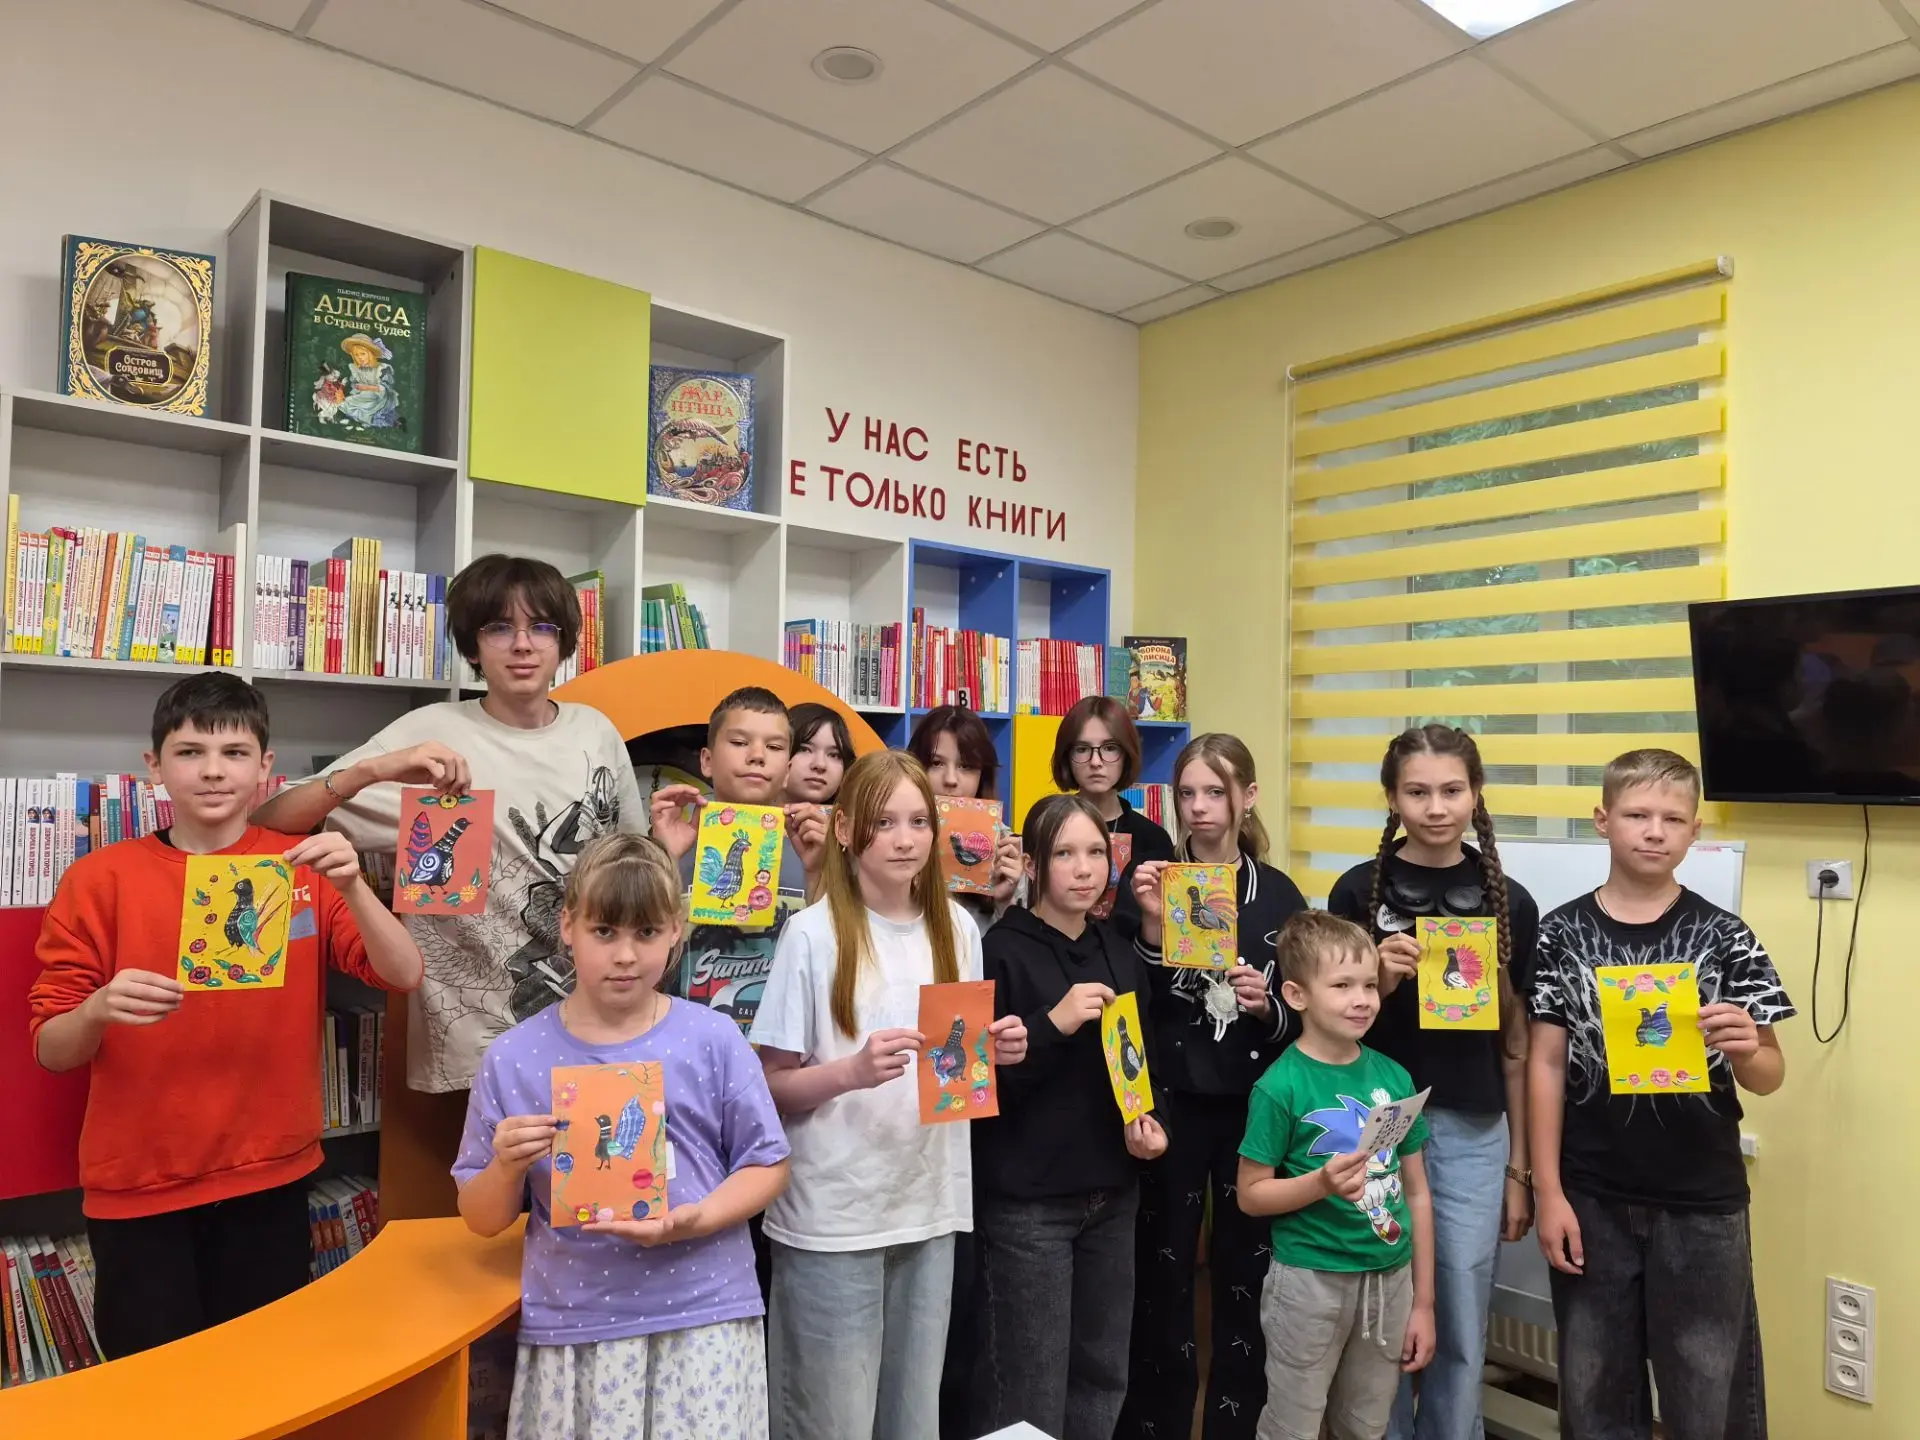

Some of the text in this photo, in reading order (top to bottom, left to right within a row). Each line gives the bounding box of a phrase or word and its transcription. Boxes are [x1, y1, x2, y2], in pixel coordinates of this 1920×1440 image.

[313, 315, 411, 338] в Стране Чудес
[314, 294, 411, 327] АЛИСА
[671, 400, 735, 418] ПТИЦА
[825, 406, 1027, 483] У НАС ЕСТЬ
[790, 459, 1066, 542] Е ТОЛЬКО КНИГИ
[692, 948, 775, 986] Summ
